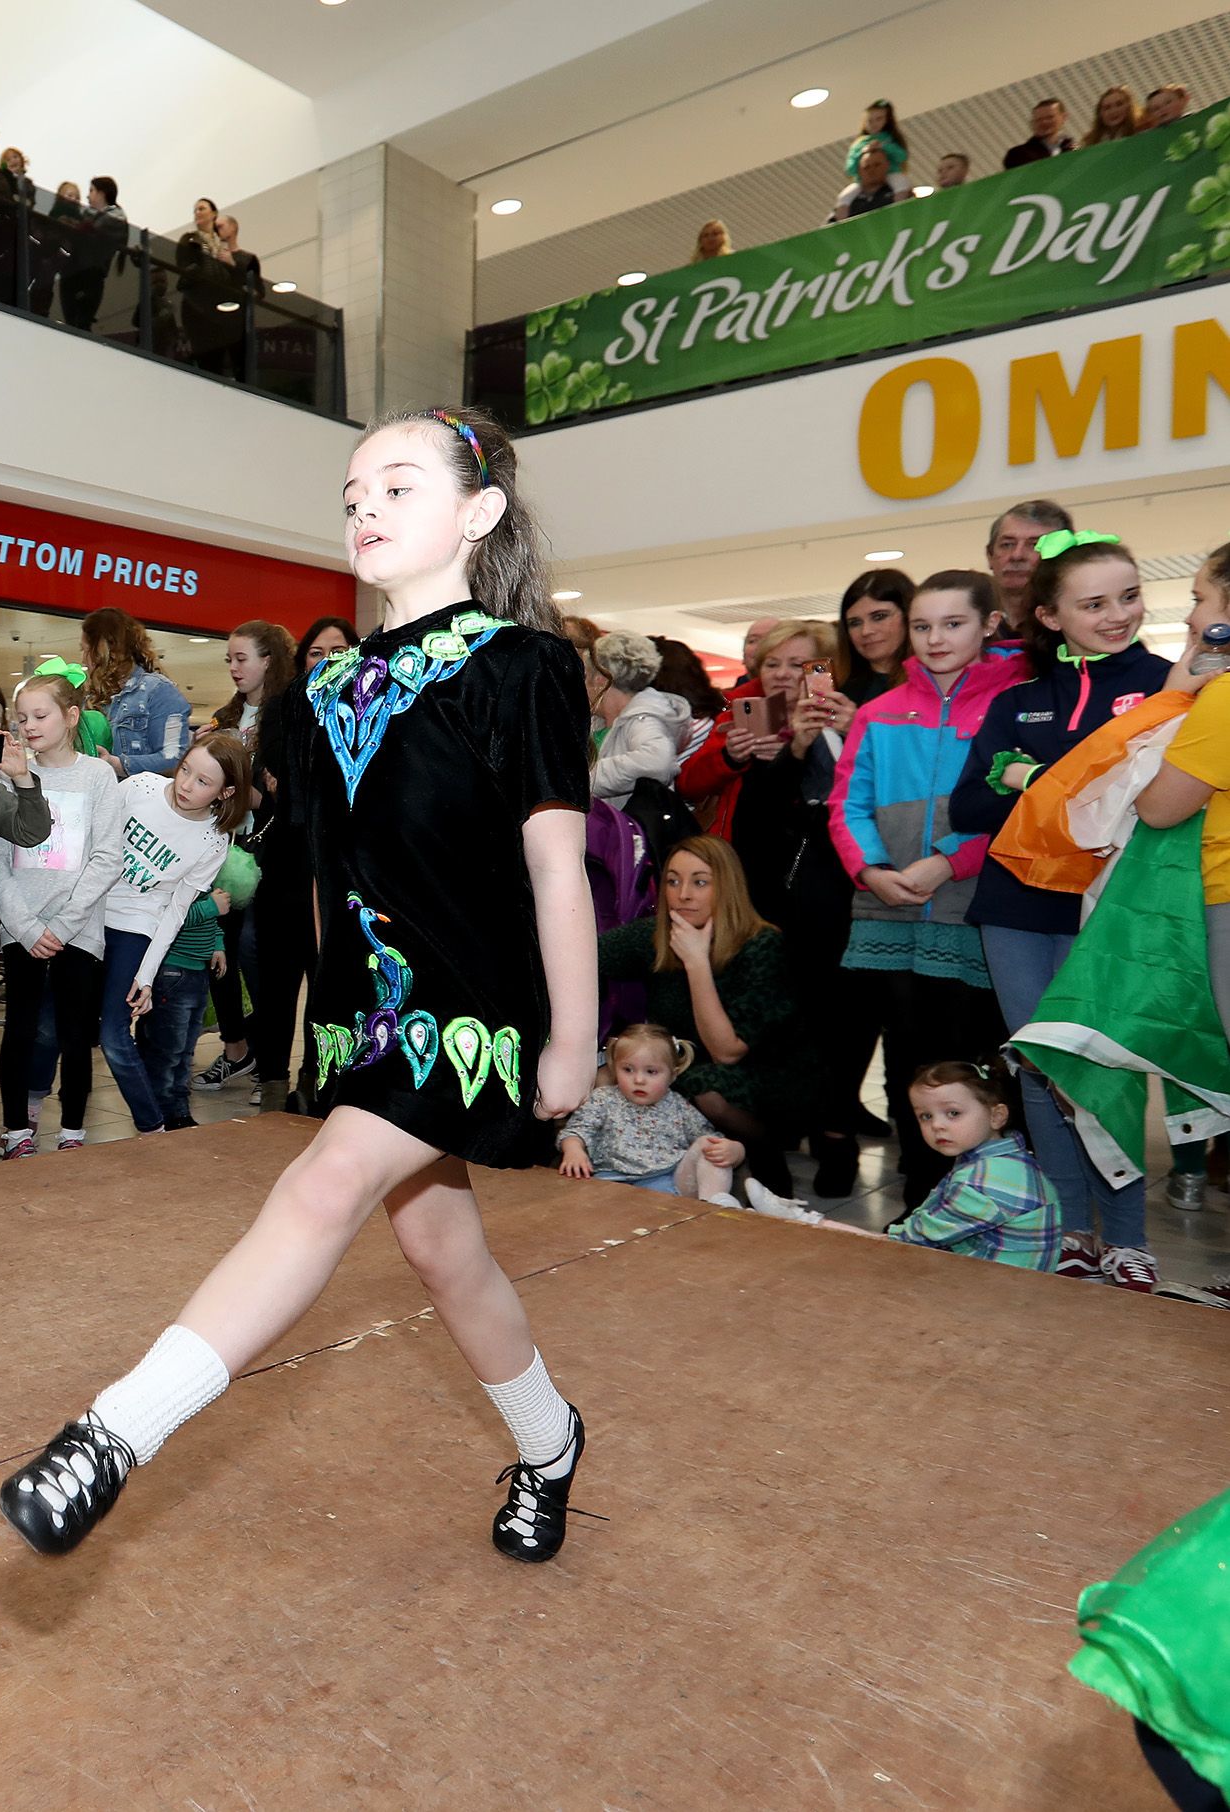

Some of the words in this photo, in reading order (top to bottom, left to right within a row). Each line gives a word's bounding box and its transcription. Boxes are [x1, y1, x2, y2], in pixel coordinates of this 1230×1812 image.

[604, 297, 678, 365] St
[680, 220, 980, 349] Patrick's
[989, 187, 1169, 284] Day
[93, 553, 199, 596] PRICES
[122, 815, 182, 872] FEELIN'
